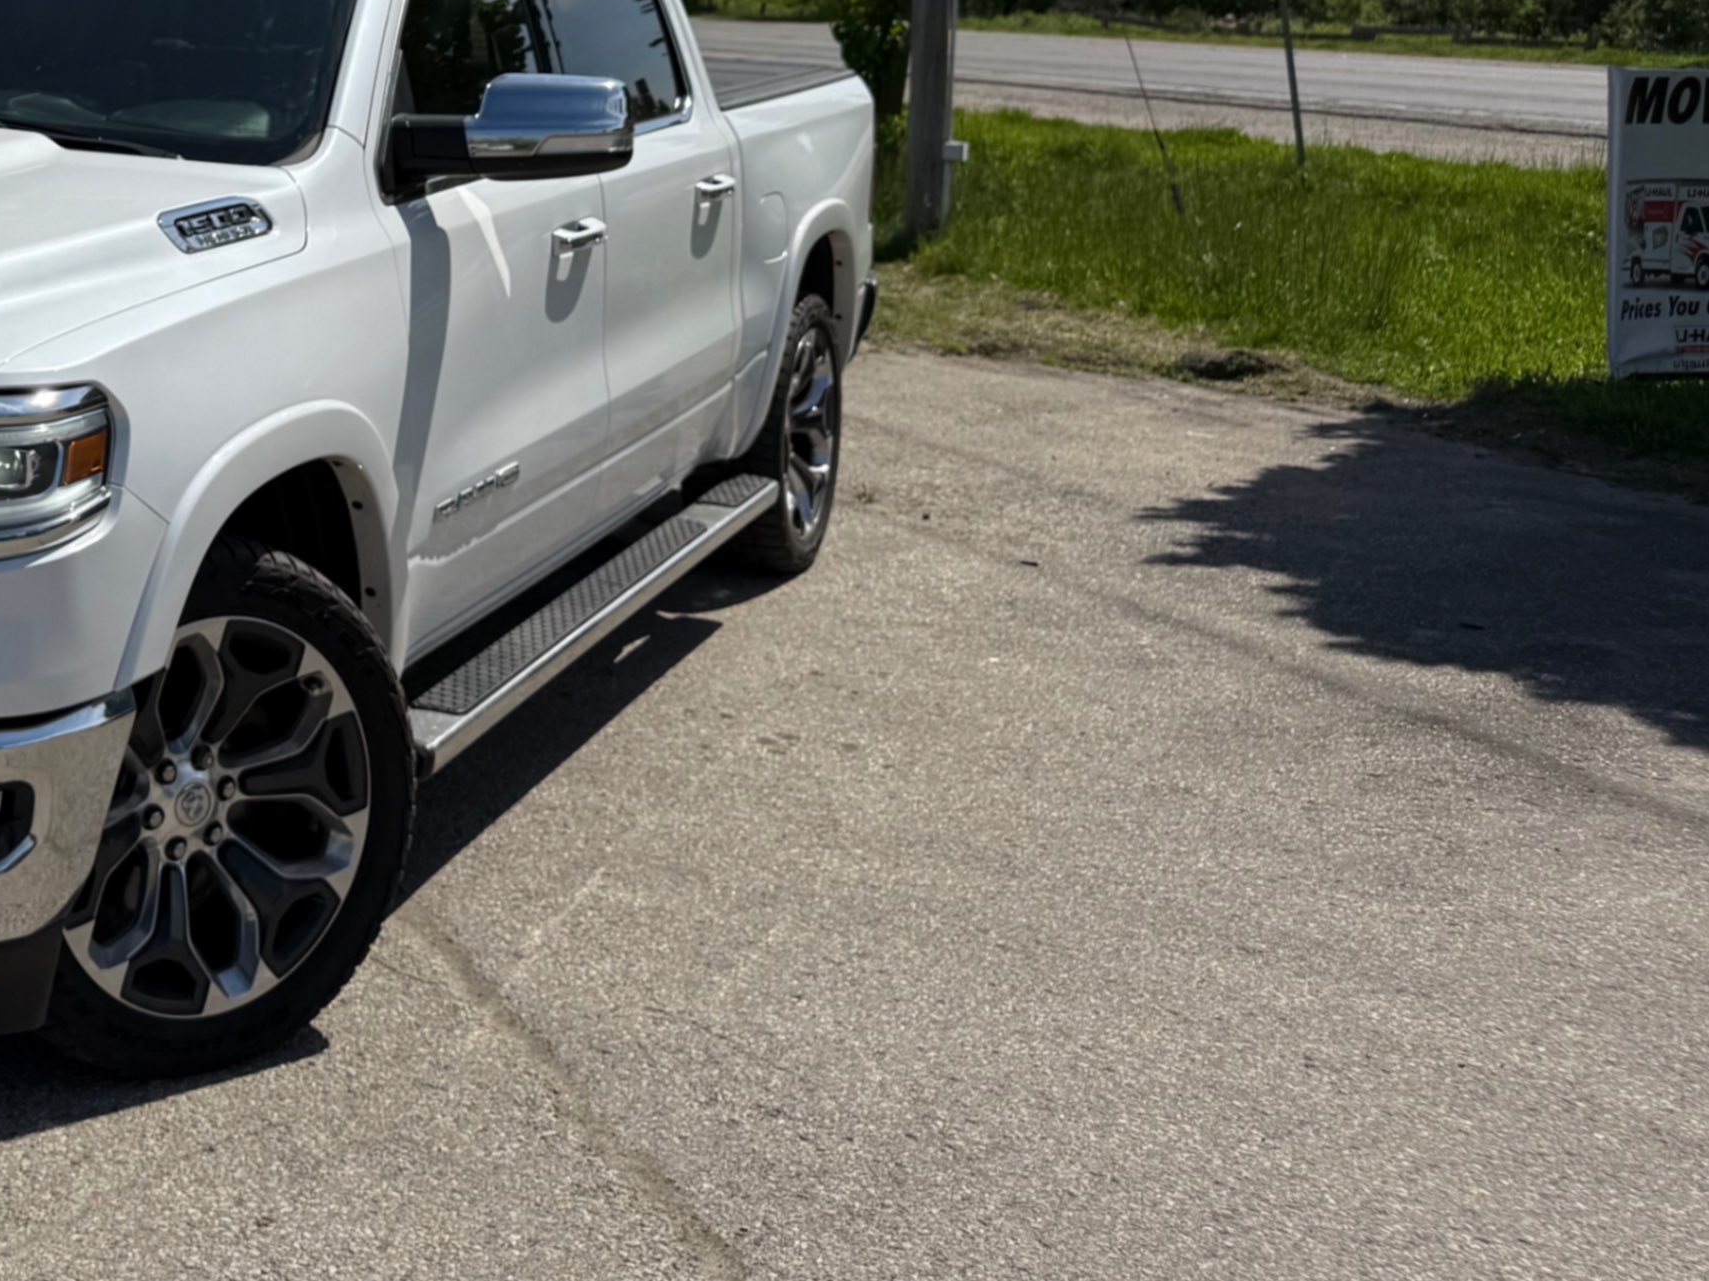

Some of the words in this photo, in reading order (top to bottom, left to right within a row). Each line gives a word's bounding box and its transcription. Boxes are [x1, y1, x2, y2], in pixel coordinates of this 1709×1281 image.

[1624, 76, 1709, 125] MO
[1620, 296, 1662, 321] Prices
[1668, 295, 1700, 317] You
